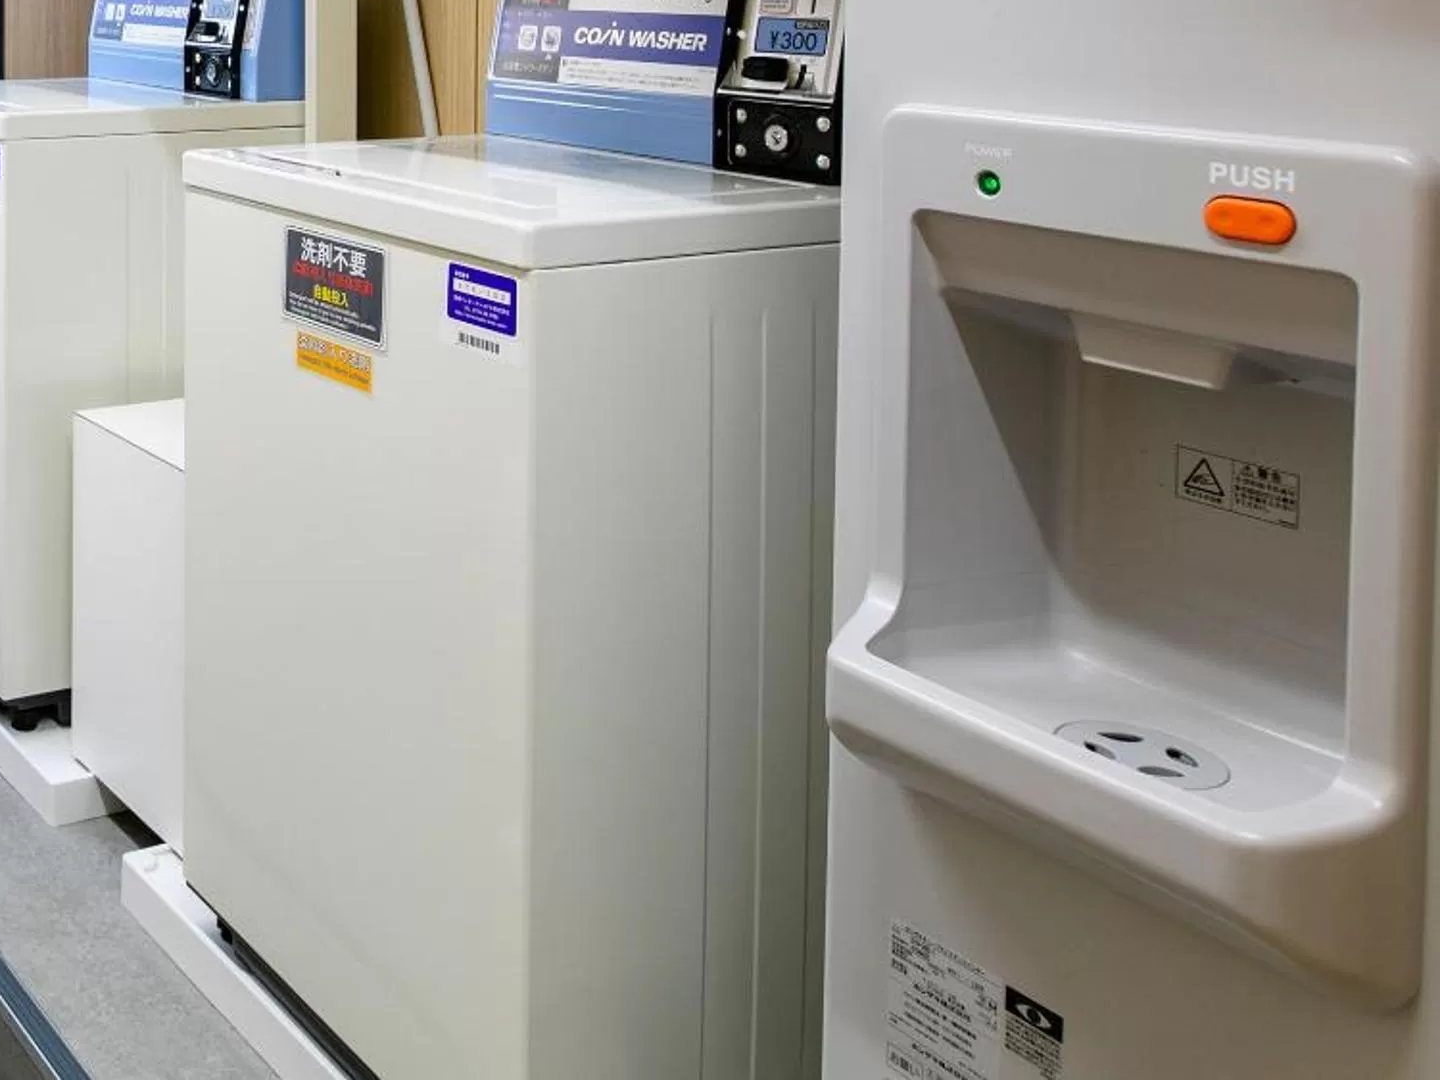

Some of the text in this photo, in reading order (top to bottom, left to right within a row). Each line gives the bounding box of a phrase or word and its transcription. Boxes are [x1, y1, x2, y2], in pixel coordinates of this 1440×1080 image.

[574, 21, 708, 52] COIN WASHER
[770, 30, 818, 51] ¥300
[1209, 162, 1297, 192] PUSH
[300, 237, 368, 278] 洗剤不要
